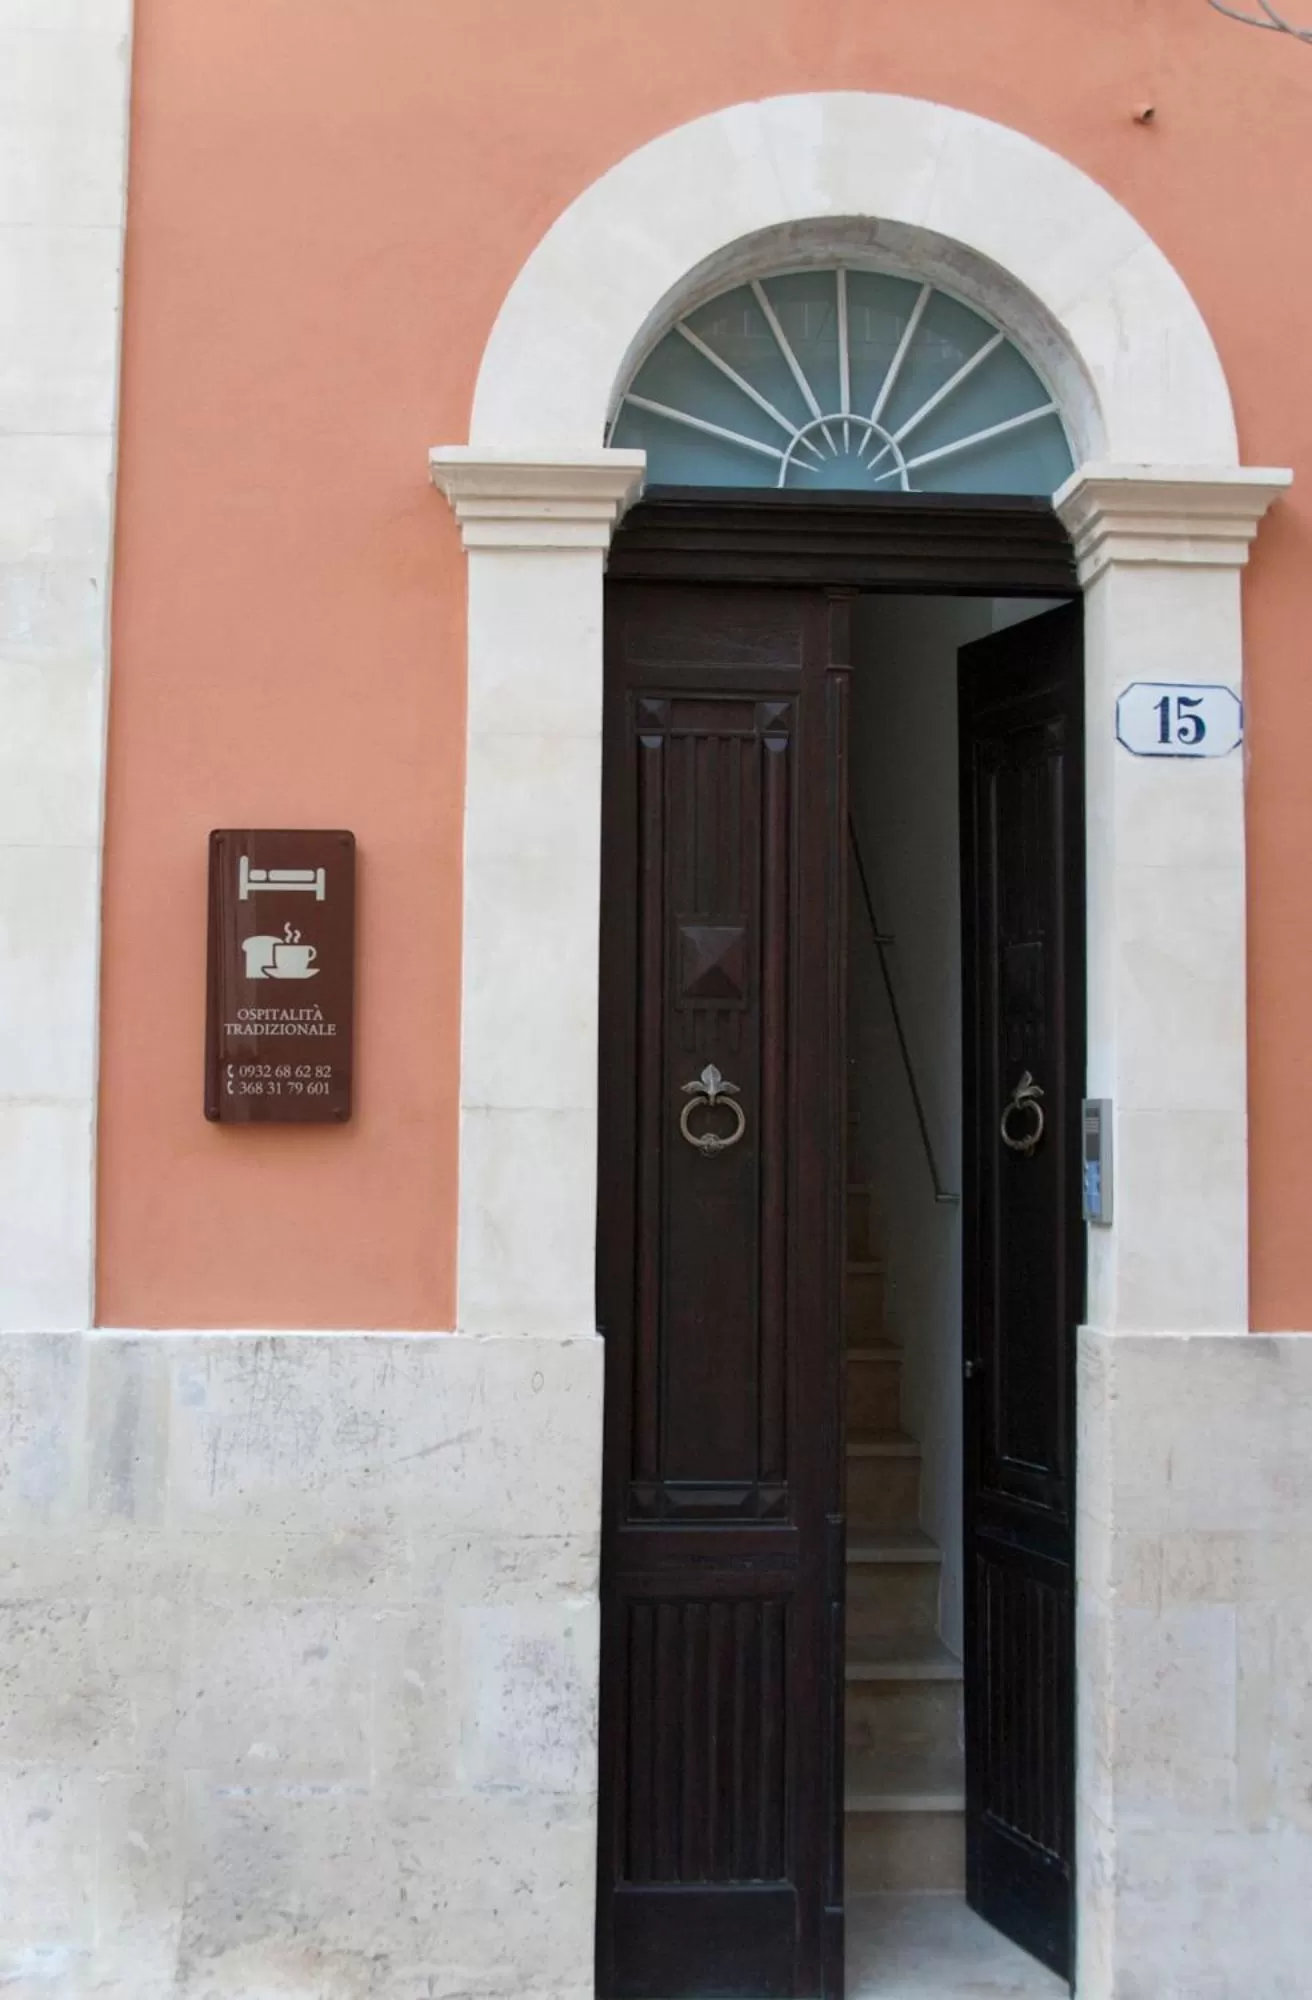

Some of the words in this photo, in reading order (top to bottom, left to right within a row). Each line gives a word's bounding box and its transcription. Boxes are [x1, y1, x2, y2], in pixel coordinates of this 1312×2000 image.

[1153, 696, 1206, 745] 15
[237, 1004, 323, 1021] OSPITALITÀ
[224, 1023, 337, 1036] TRADIZIONALE
[239, 1065, 272, 1078] 0932
[275, 1064, 292, 1078] 68
[295, 1064, 312, 1078] 62
[315, 1065, 332, 1078] 82
[239, 1081, 264, 1095] 368
[267, 1081, 281, 1095] 31
[287, 1081, 304, 1095] 79
[307, 1081, 330, 1095] 601
